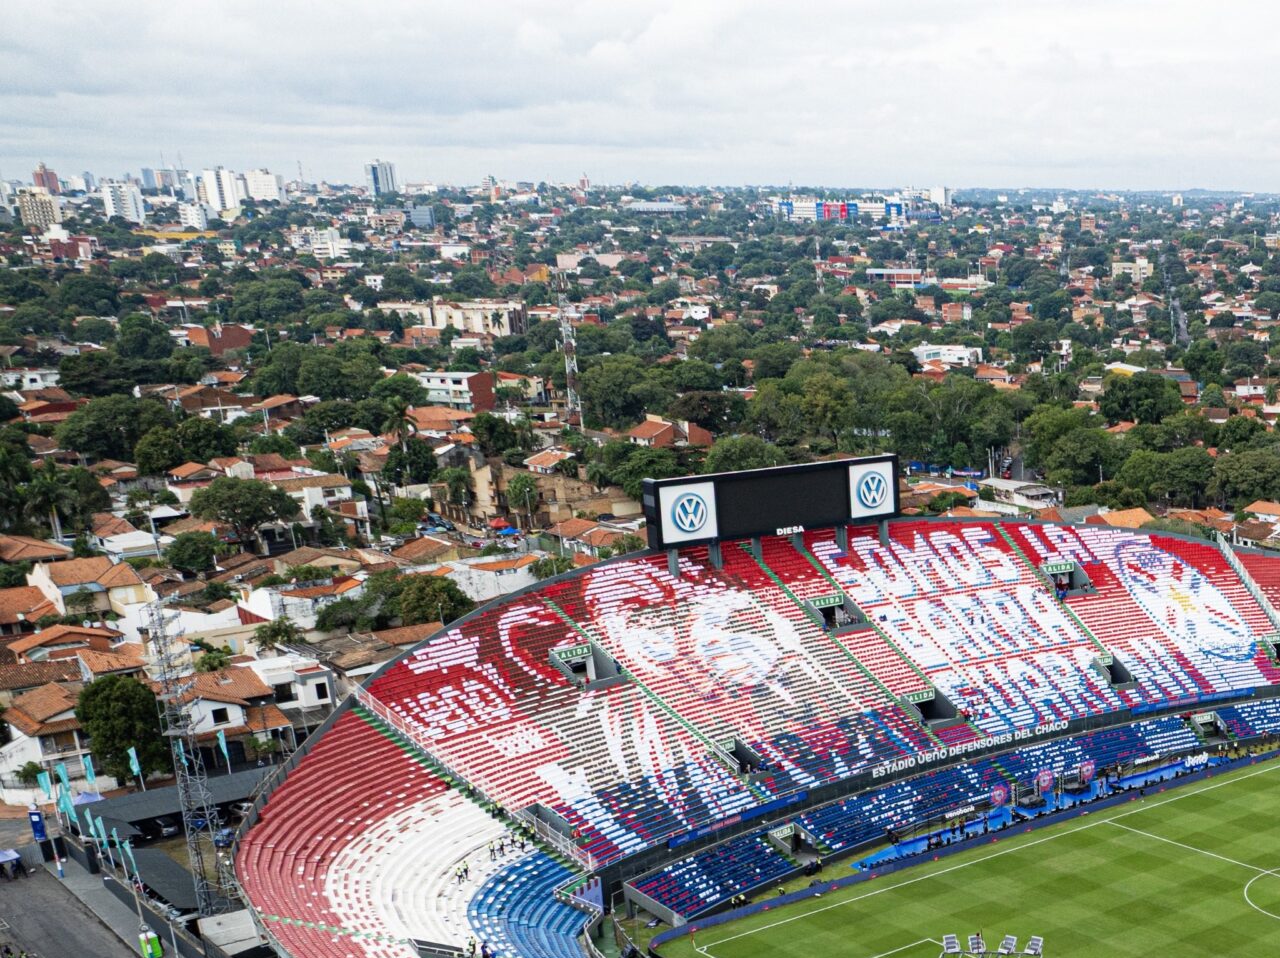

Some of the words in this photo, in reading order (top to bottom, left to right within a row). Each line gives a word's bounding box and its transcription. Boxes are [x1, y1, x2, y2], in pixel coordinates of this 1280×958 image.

[776, 525, 804, 536] DIESA
[872, 757, 916, 778] ESTADIO
[949, 735, 1013, 757] DEFENSORES
[1014, 728, 1033, 741] DEL
[1035, 721, 1069, 735] CHACO
